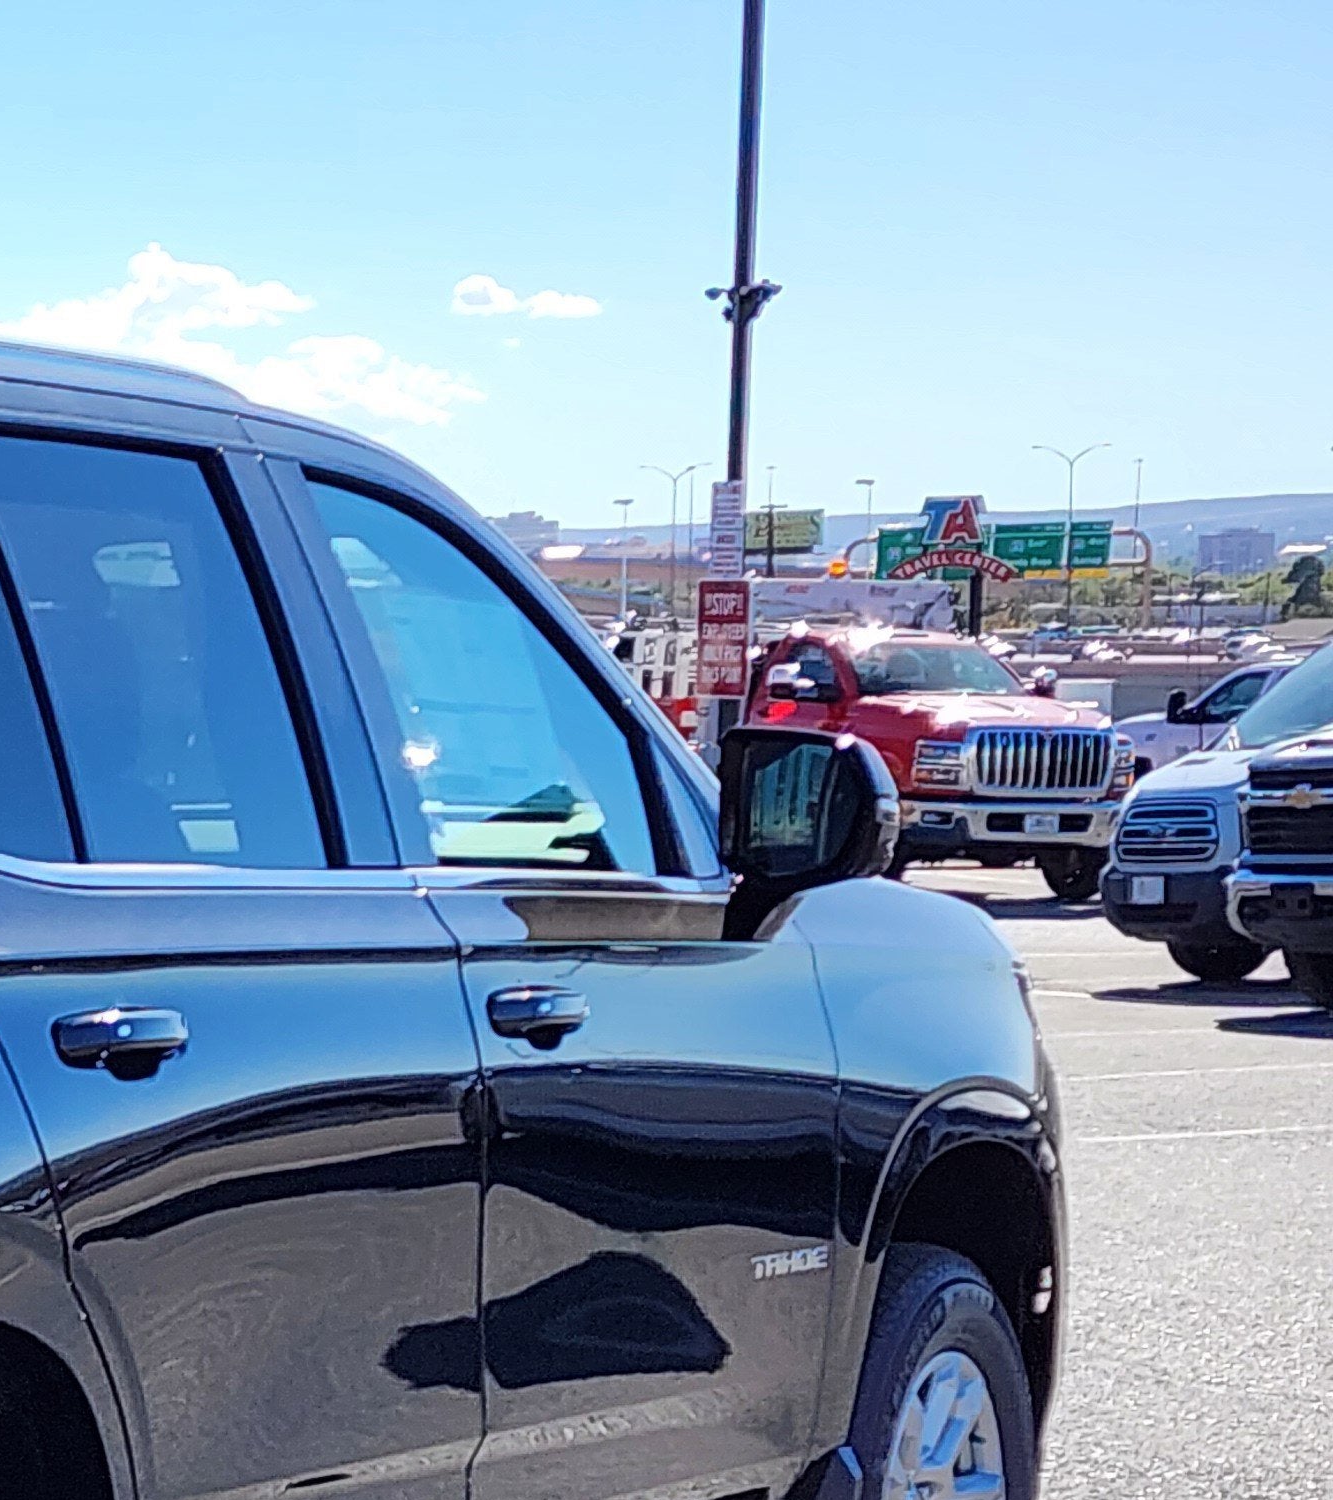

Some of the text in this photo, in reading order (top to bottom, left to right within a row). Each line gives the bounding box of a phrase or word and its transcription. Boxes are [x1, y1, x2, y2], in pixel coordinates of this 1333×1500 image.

[893, 552, 950, 578] TRAVEL
[953, 552, 1008, 577] CENTER
[750, 1245, 829, 1280] TAHOE
